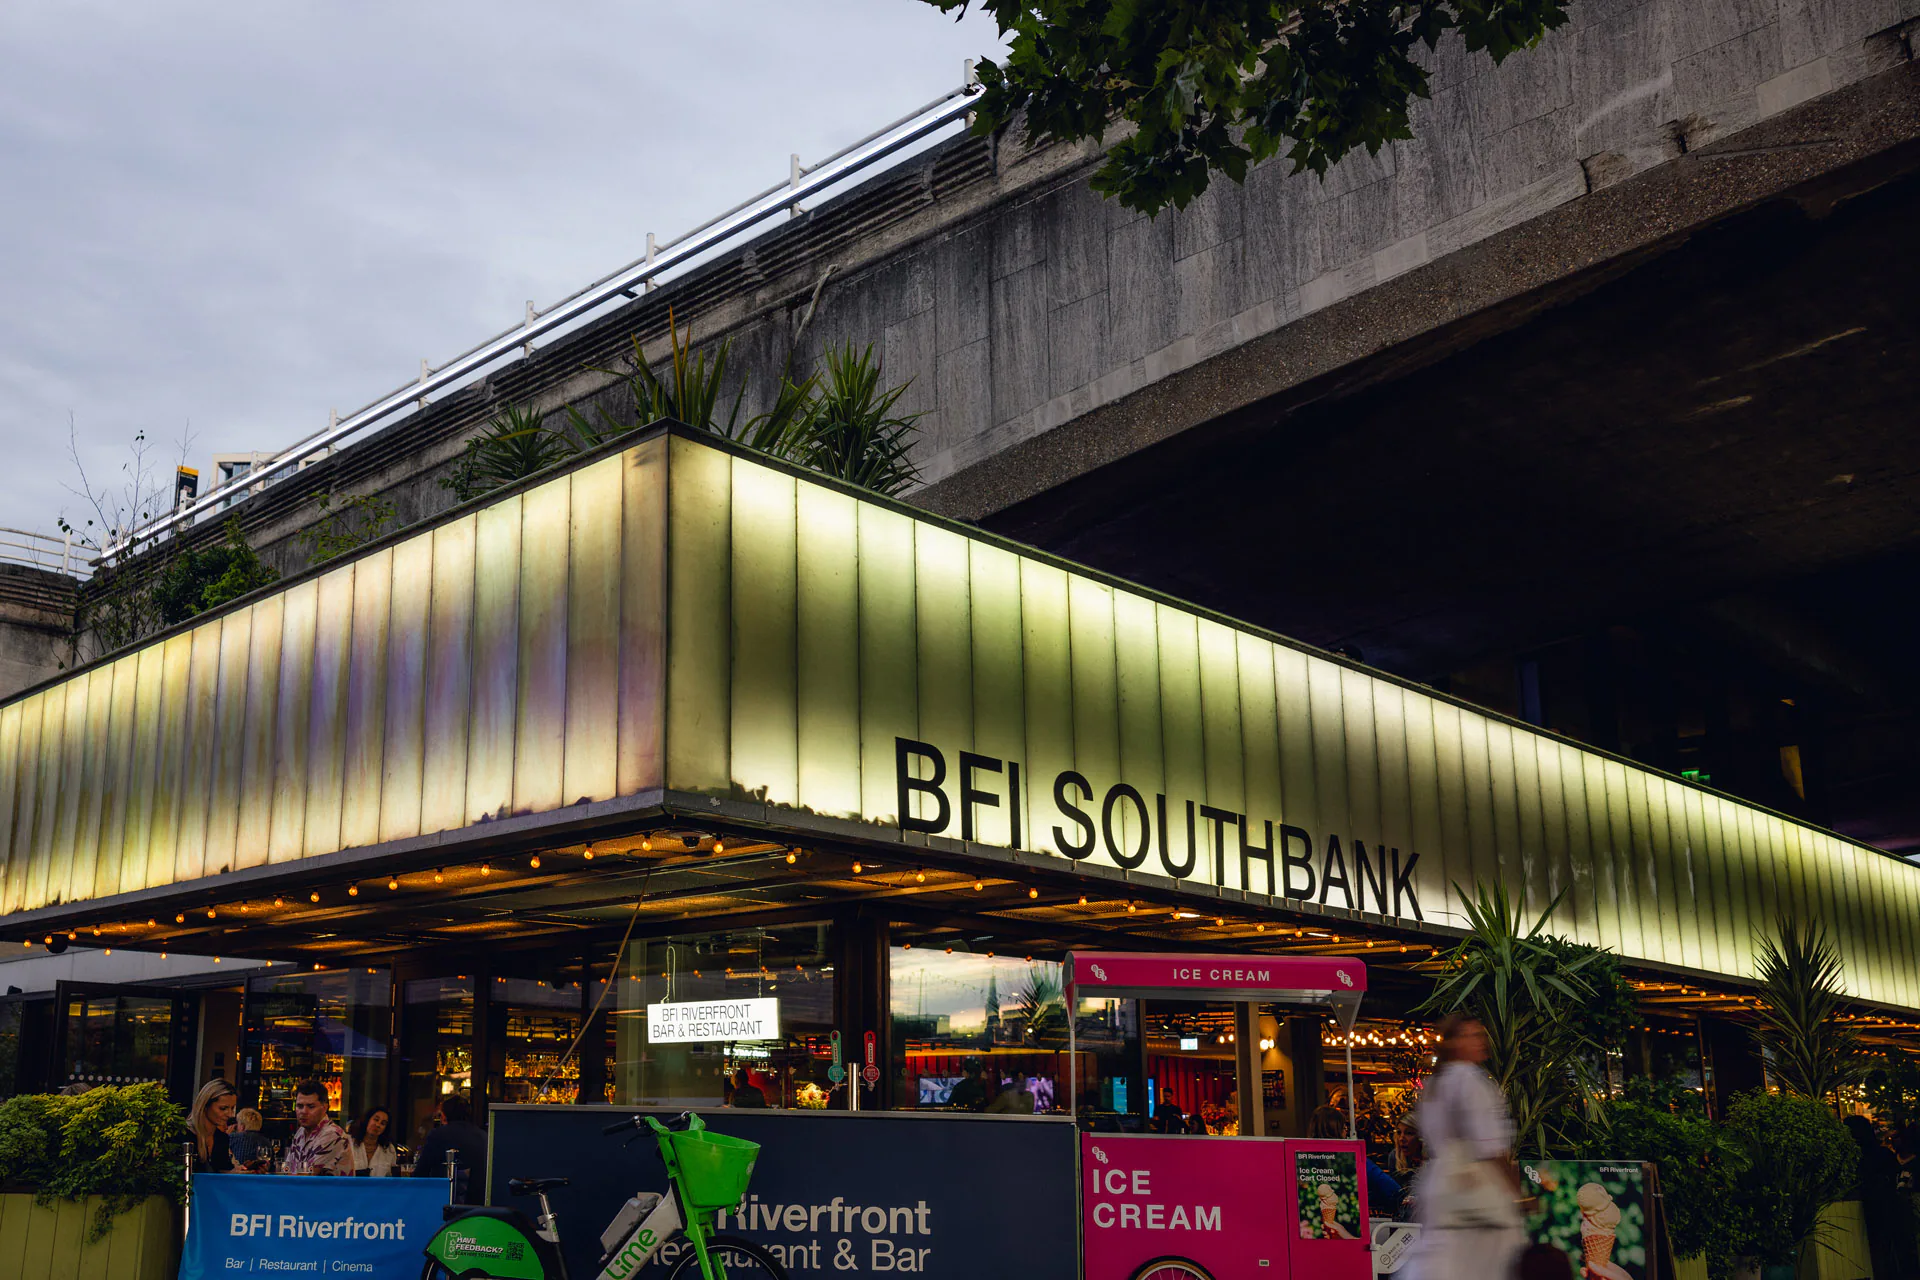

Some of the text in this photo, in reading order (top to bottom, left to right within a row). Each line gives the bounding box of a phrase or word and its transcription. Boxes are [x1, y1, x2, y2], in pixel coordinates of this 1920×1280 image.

[895, 736, 1424, 922] BFI SOUTHBANK
[1173, 968, 1271, 982] ICE CREAM
[662, 1004, 752, 1022] BFI RIVERFRONT
[653, 1020, 763, 1038] BAR & RESTAURANT
[1299, 1174, 1315, 1182] Cart
[1610, 1166, 1639, 1174] Riverfront
[1092, 1169, 1152, 1196] ICE
[1092, 1202, 1223, 1232] CREAM
[230, 1213, 406, 1241] BFI Riverfront
[455, 1244, 504, 1254] FEEDBACK?
[456, 1237, 477, 1245] HAVE
[833, 1238, 858, 1271] &
[871, 1239, 931, 1273] Bar
[225, 1257, 373, 1273] Bar Restaurant Cinema
